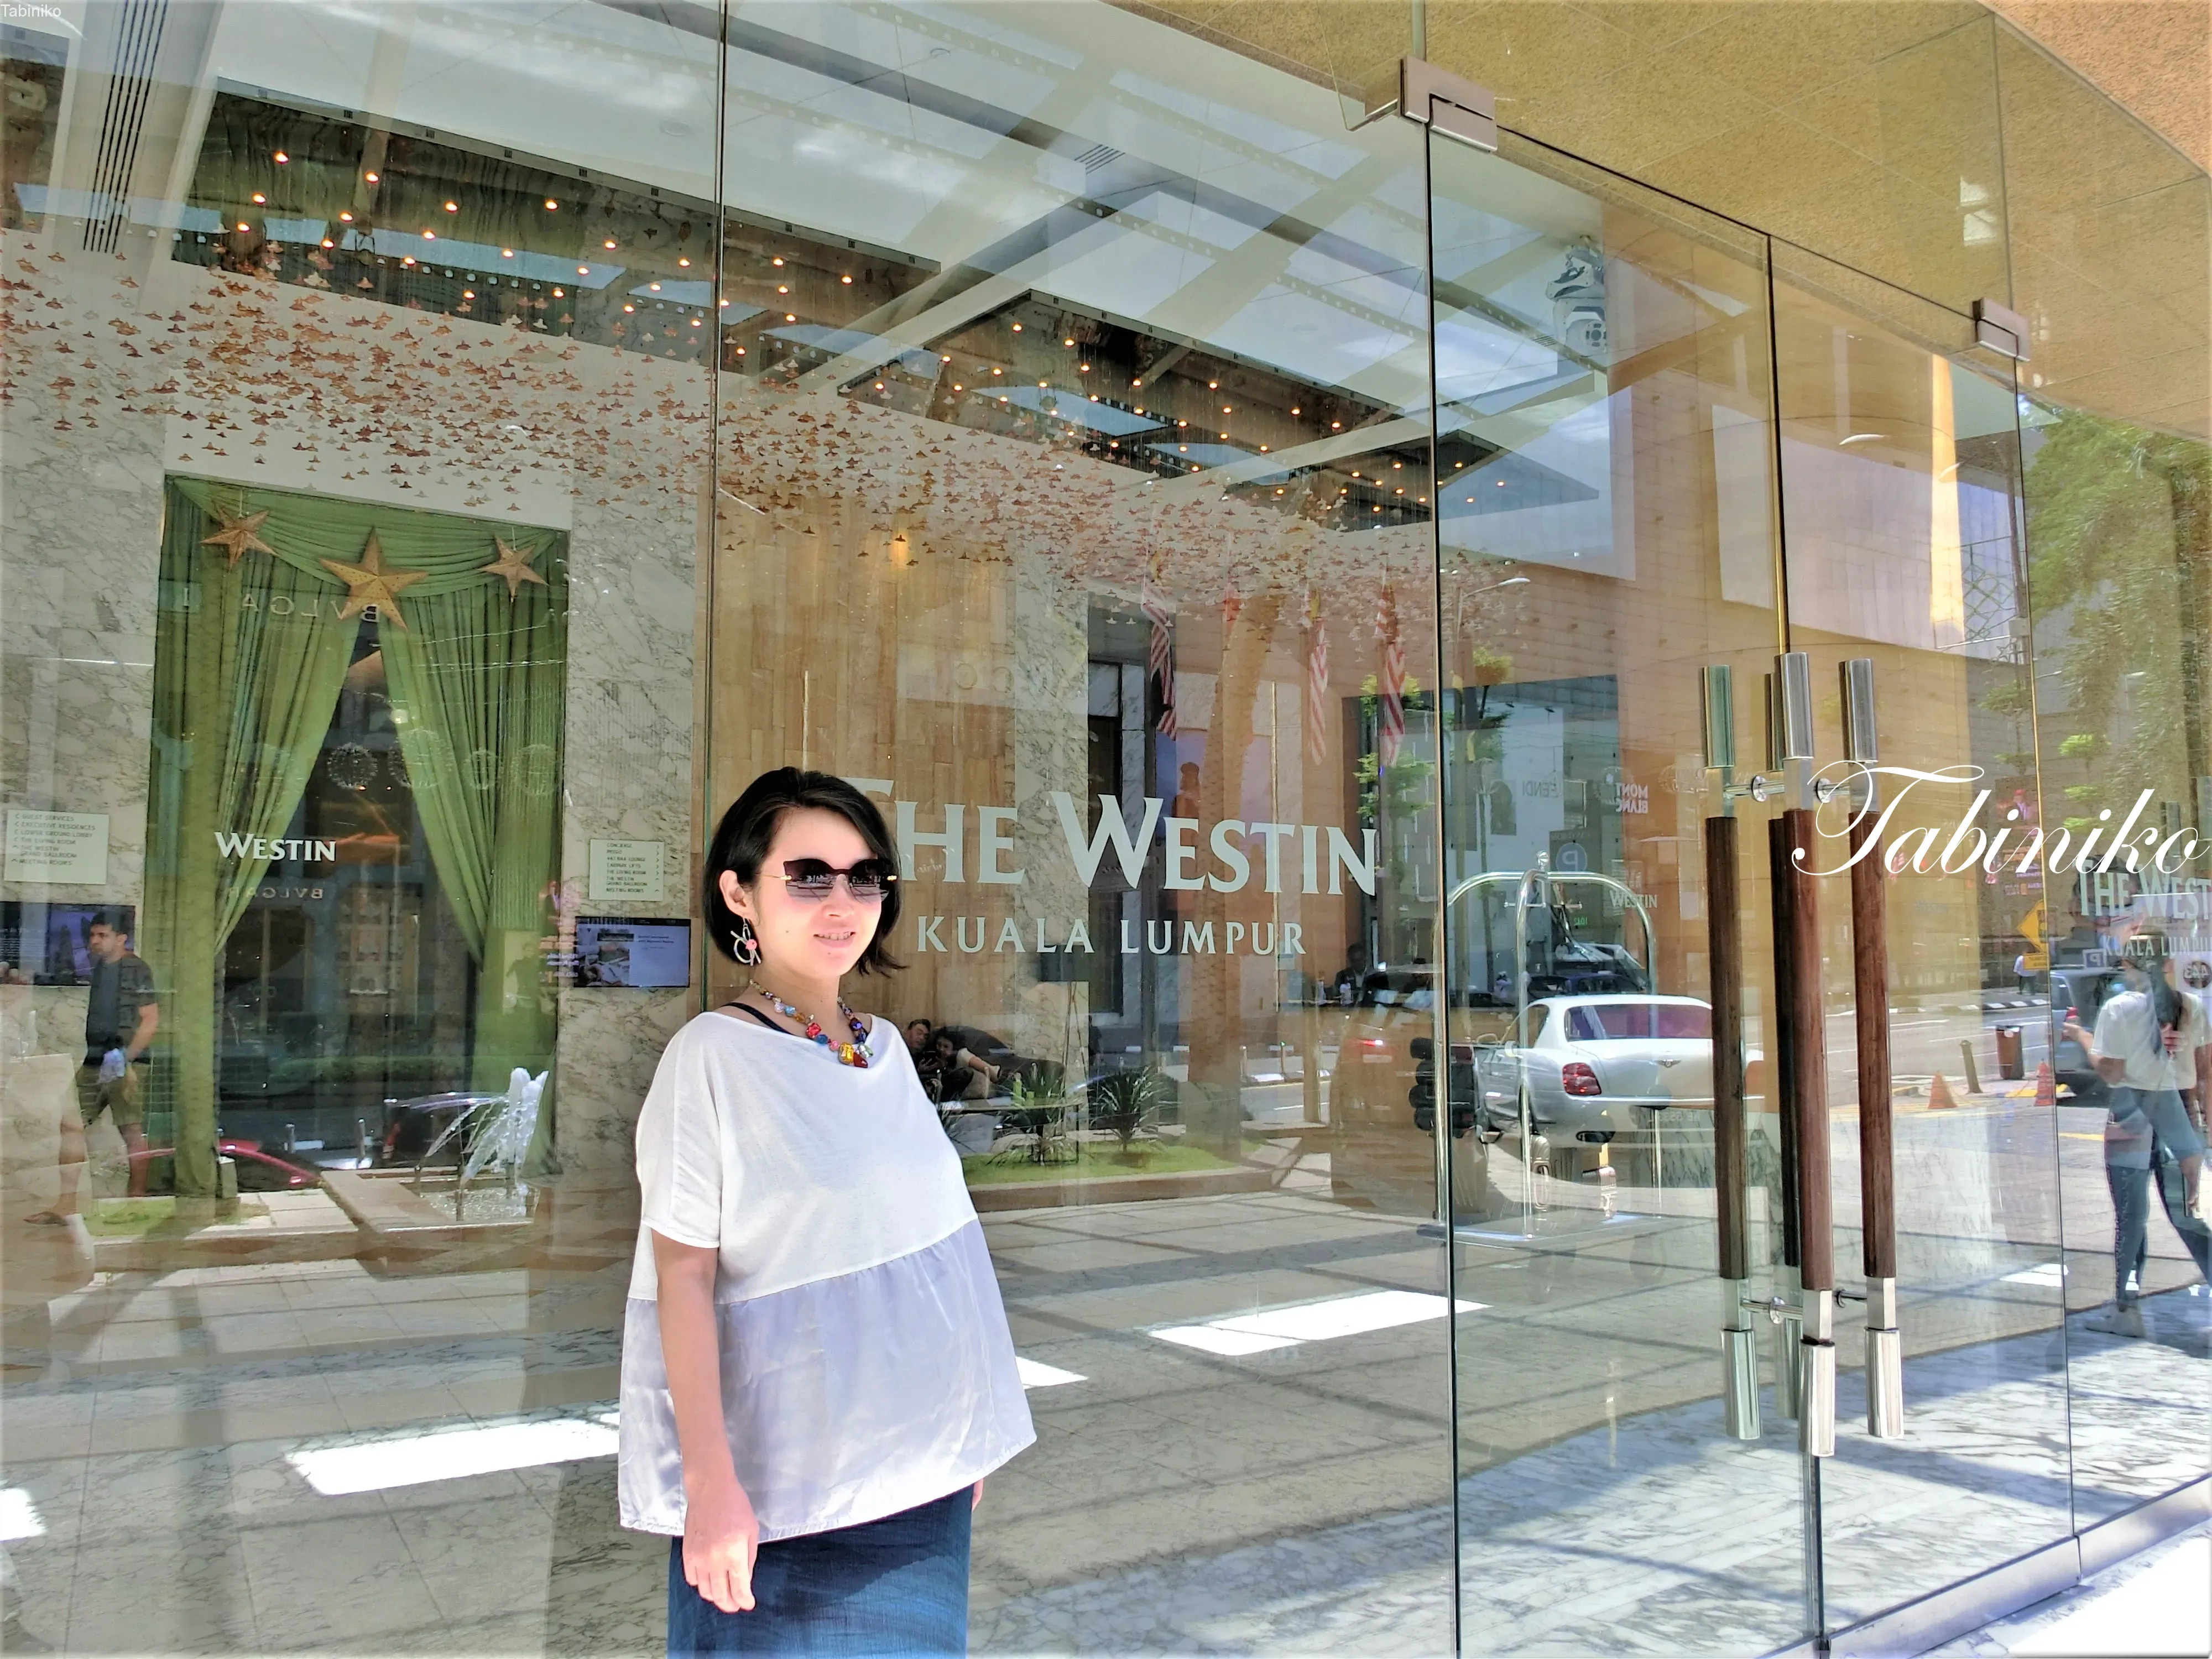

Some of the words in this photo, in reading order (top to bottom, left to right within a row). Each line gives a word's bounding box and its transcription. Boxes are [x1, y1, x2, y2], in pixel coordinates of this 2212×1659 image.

[214, 832, 336, 862] WESTIN
[1049, 791, 1378, 896] WESTIN
[917, 916, 1094, 953] KUALA
[1119, 919, 1306, 955] LUMPUR
